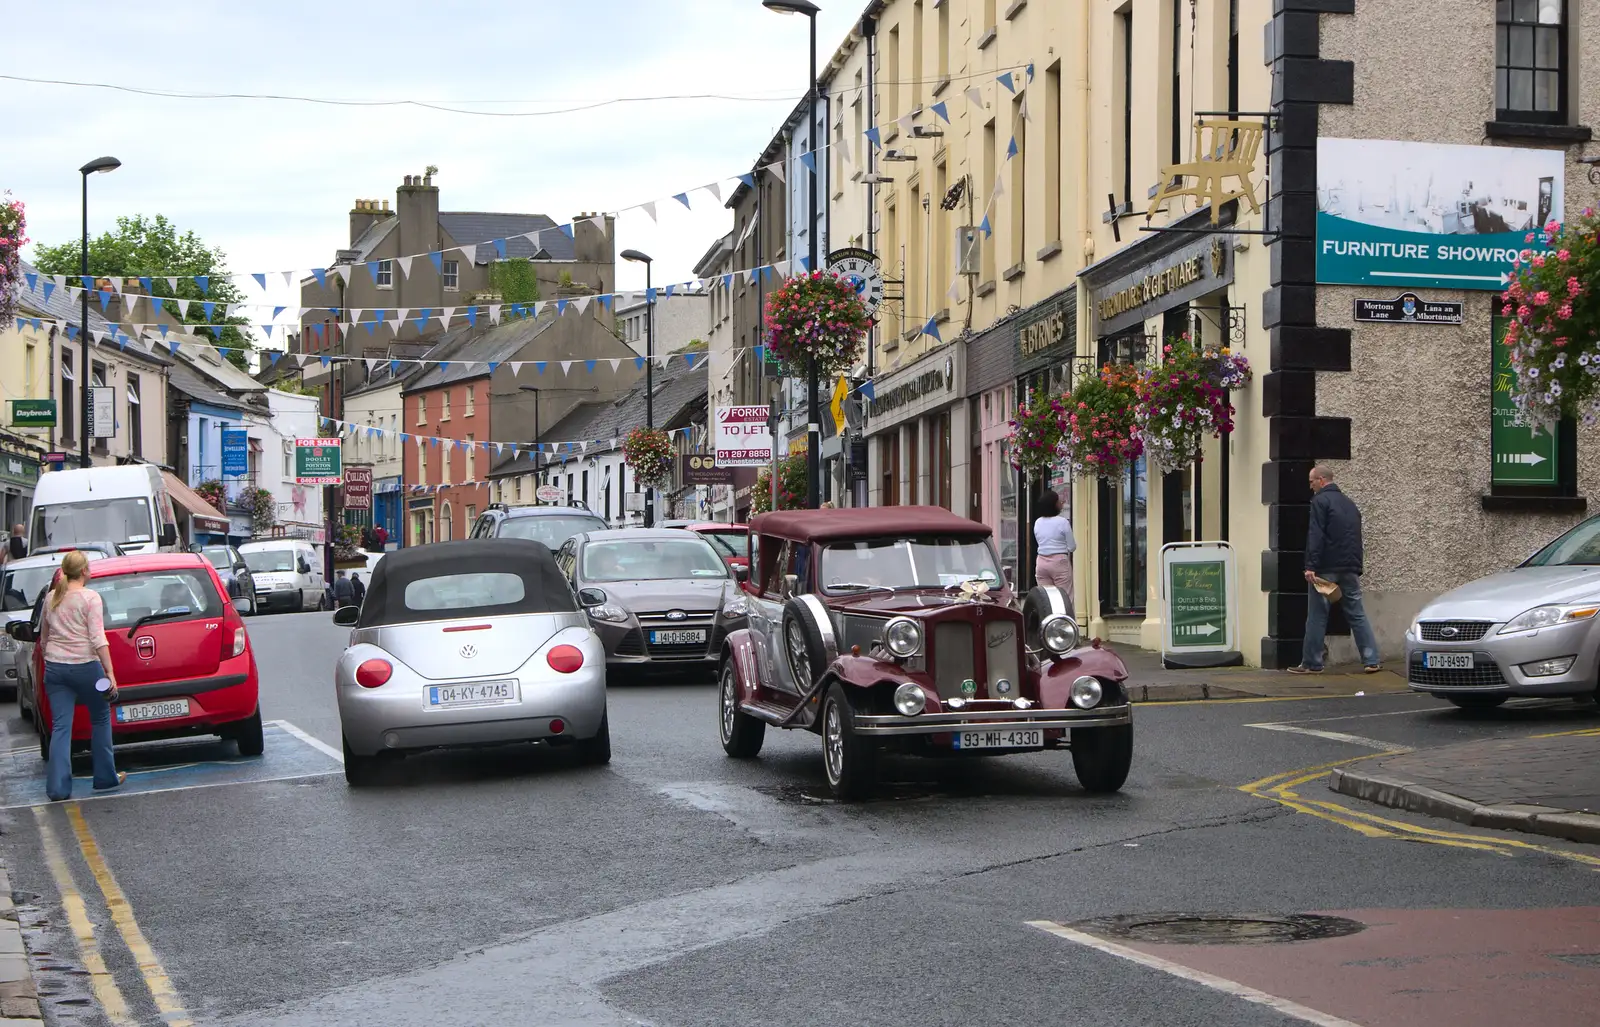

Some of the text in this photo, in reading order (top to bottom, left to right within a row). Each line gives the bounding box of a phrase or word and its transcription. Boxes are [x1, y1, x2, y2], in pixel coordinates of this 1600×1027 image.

[854, 250, 873, 260] DISTRICT
[1322, 240, 1429, 259] FURNITURE
[1143, 276, 1150, 302] &
[1151, 255, 1201, 298] GIFTWARE
[1363, 302, 1394, 310] Mortons
[16, 409, 52, 418] Daybreak
[731, 408, 770, 418] FORKIN
[722, 425, 765, 435] TO LET
[345, 494, 370, 507] BUTCHERS
[660, 632, 700, 641] 141-D-15884
[1430, 656, 1470, 668] 07-D-84997
[442, 684, 508, 701] 04-KY-4745
[130, 703, 182, 719] 10-D-20888
[964, 732, 1039, 747] 93-MH-4330
